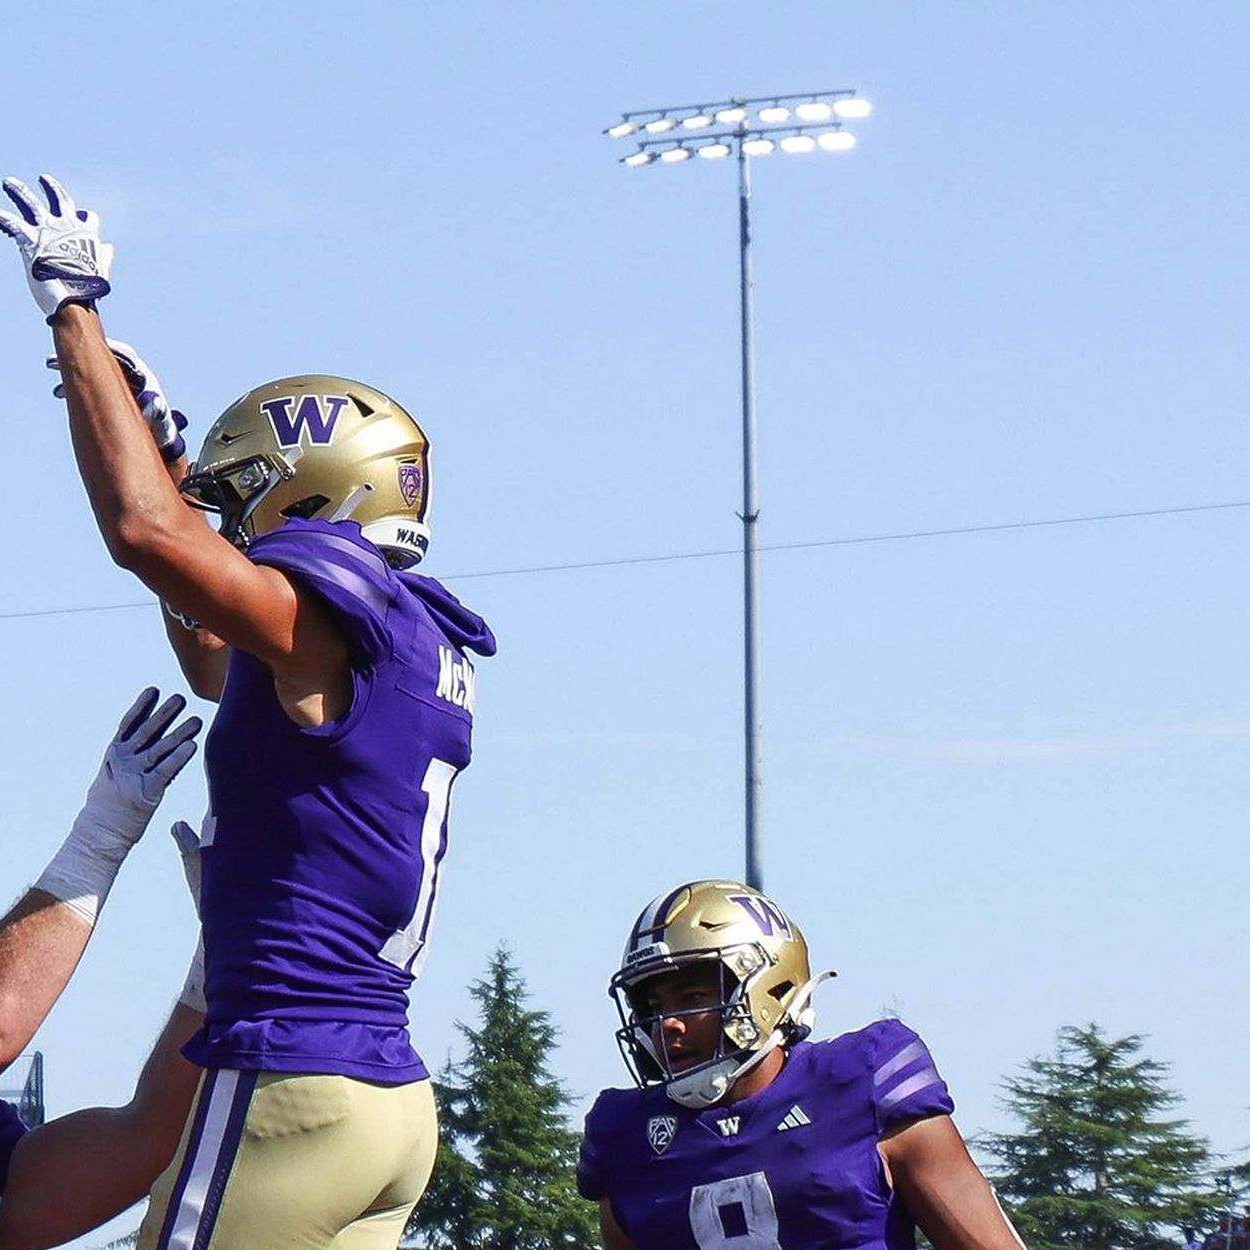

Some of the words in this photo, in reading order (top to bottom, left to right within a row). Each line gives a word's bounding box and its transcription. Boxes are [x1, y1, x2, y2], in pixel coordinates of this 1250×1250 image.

[261, 394, 349, 449] W
[725, 894, 793, 941] W
[653, 1131, 668, 1145] 12
[716, 1116, 742, 1138] W
